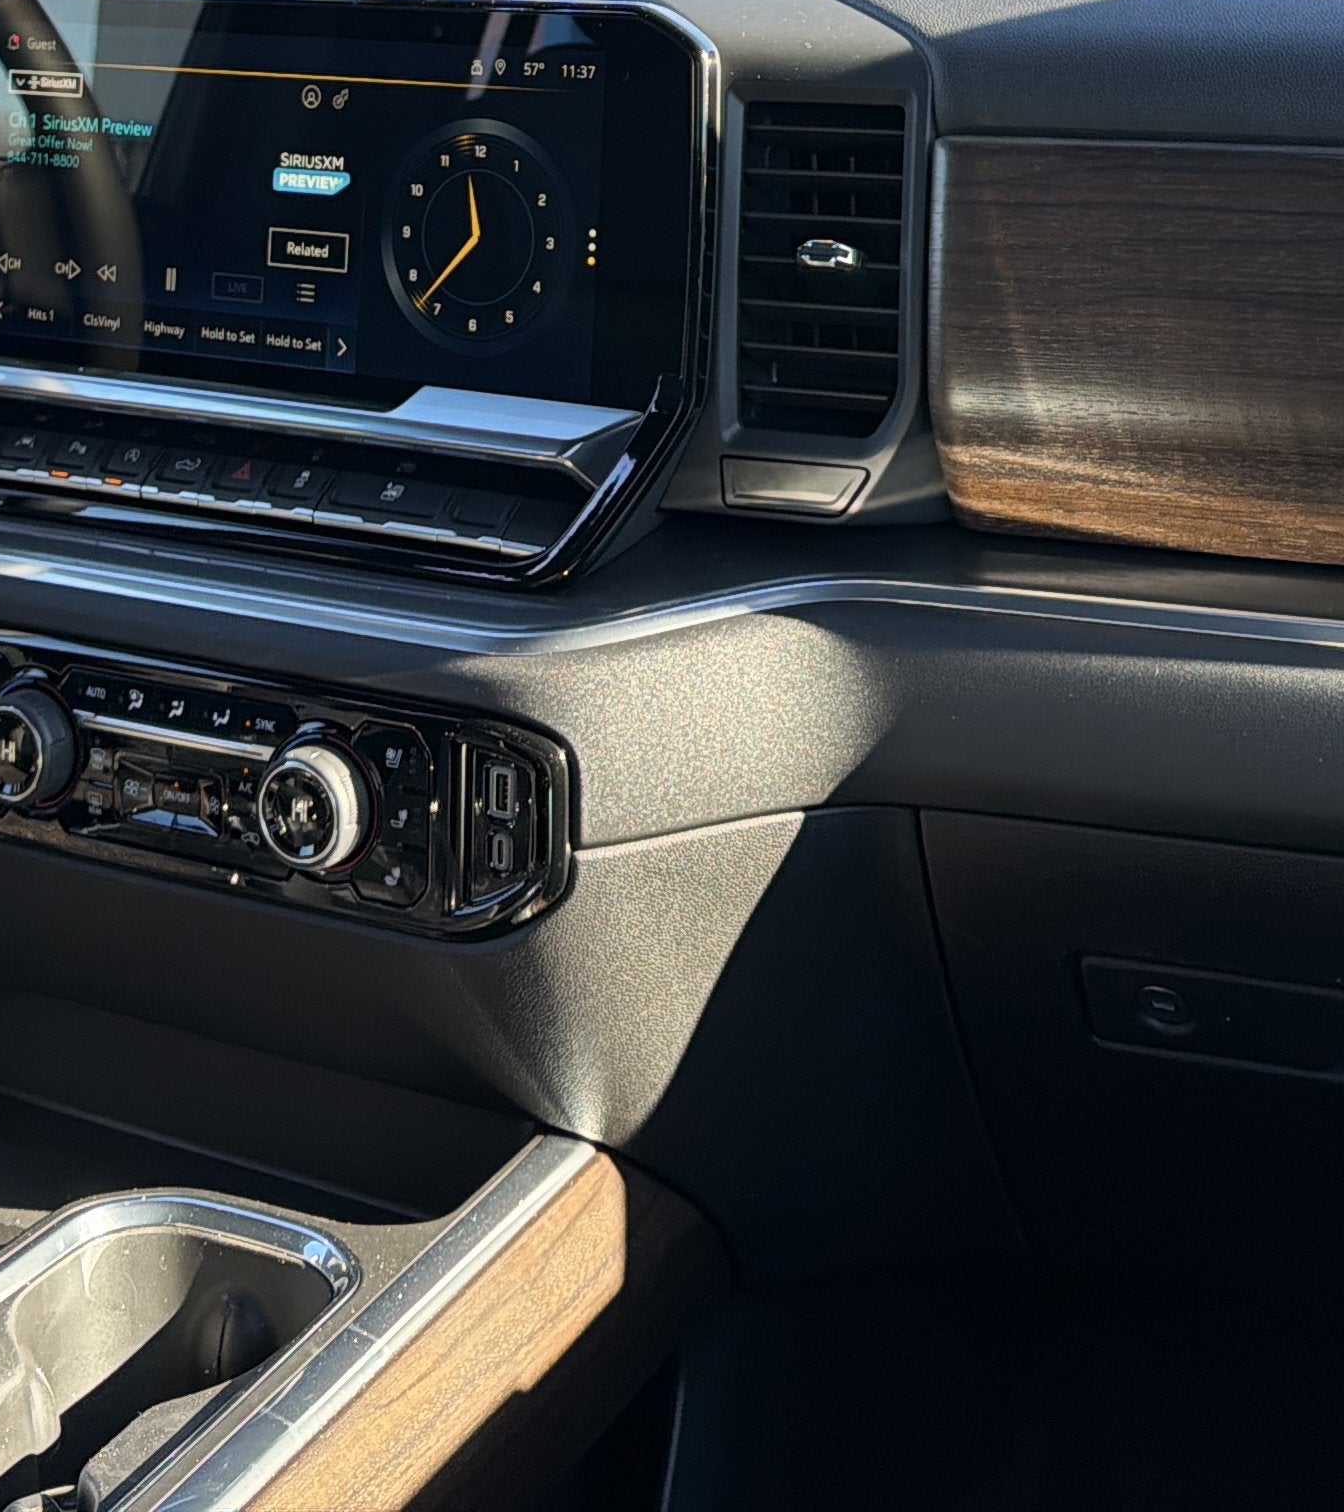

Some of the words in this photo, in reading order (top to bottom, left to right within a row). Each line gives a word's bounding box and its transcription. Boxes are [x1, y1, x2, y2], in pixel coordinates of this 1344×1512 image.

[27, 38, 57, 51] Guest
[561, 65, 596, 79] 11:37
[9, 112, 30, 129] Ch
[43, 114, 98, 133] SiriusXM
[102, 118, 153, 137] Preview
[8, 134, 36, 148] Great
[38, 136, 65, 150] Offer
[474, 145, 487, 158] 12
[280, 152, 344, 170] SIRIUSXM
[440, 154, 450, 167] 11
[513, 160, 520, 172] 1
[279, 173, 344, 190] PREVIEW
[410, 183, 424, 197] 10
[537, 193, 547, 207] 2
[402, 225, 411, 238] 9
[286, 241, 329, 258] Related
[545, 237, 555, 250] 3
[408, 269, 418, 282] 8
[532, 281, 542, 294] 4
[27, 307, 47, 321] Hits
[433, 303, 442, 316] 7
[505, 310, 514, 323] 5
[83, 314, 120, 331] ClsVinyl
[468, 319, 477, 332] 6
[143, 320, 185, 340] Highway
[201, 326, 224, 341] Hold
[227, 329, 236, 342] to
[239, 330, 256, 345] Set
[266, 333, 290, 348] Hold
[293, 336, 302, 350] to
[305, 338, 322, 352] Set
[85, 686, 106, 700] AUTO
[255, 718, 276, 731] SYNC
[1, 740, 16, 764] HI
